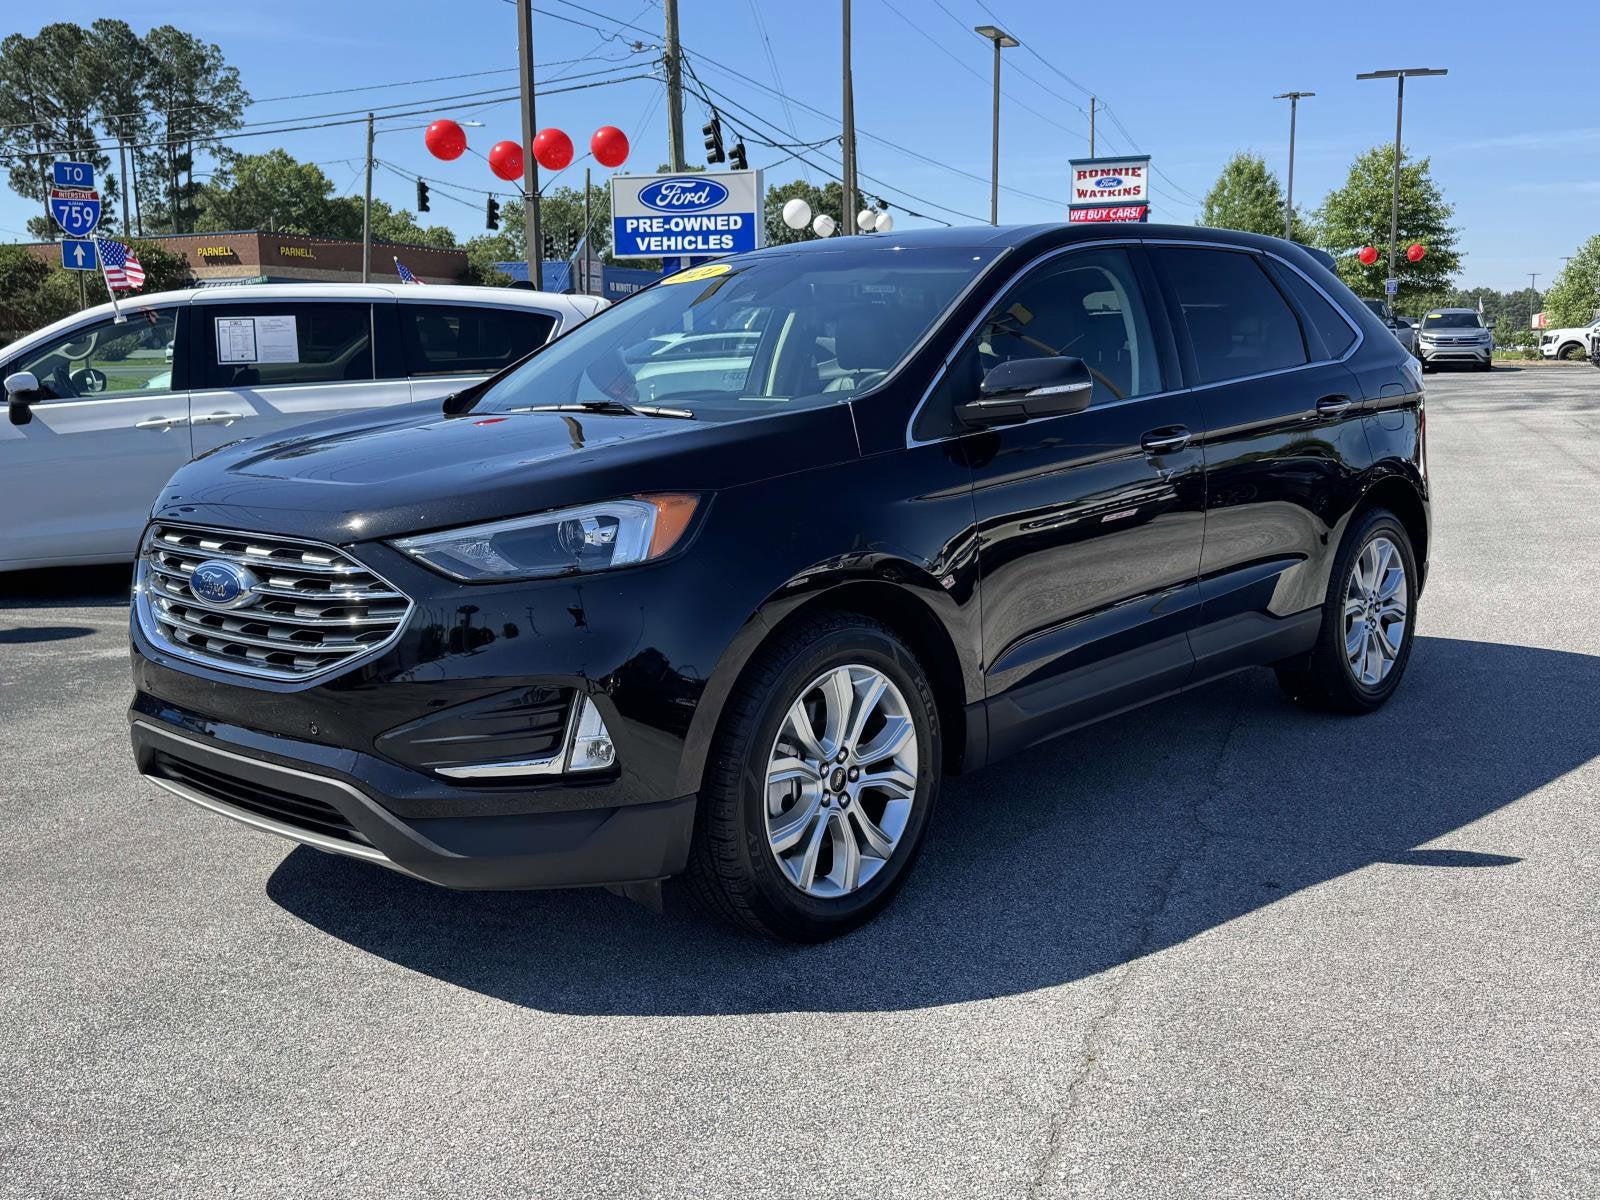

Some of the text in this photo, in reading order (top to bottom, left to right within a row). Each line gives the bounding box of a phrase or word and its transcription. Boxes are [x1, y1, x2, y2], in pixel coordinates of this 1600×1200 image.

[64, 166, 83, 181] TO
[1077, 167, 1141, 180] RONNIE
[58, 191, 92, 199] INTERSTATE
[656, 182, 711, 207] Ford
[1077, 185, 1141, 198] WATKINS
[59, 206, 94, 228] 759
[1070, 207, 1140, 220] WE BUY CARS!
[626, 215, 742, 233] PRE-OWNED
[636, 234, 734, 250] VEHICLES
[197, 246, 233, 256] PARNELL
[280, 247, 315, 258] PARNELL
[198, 571, 229, 597] Ford
